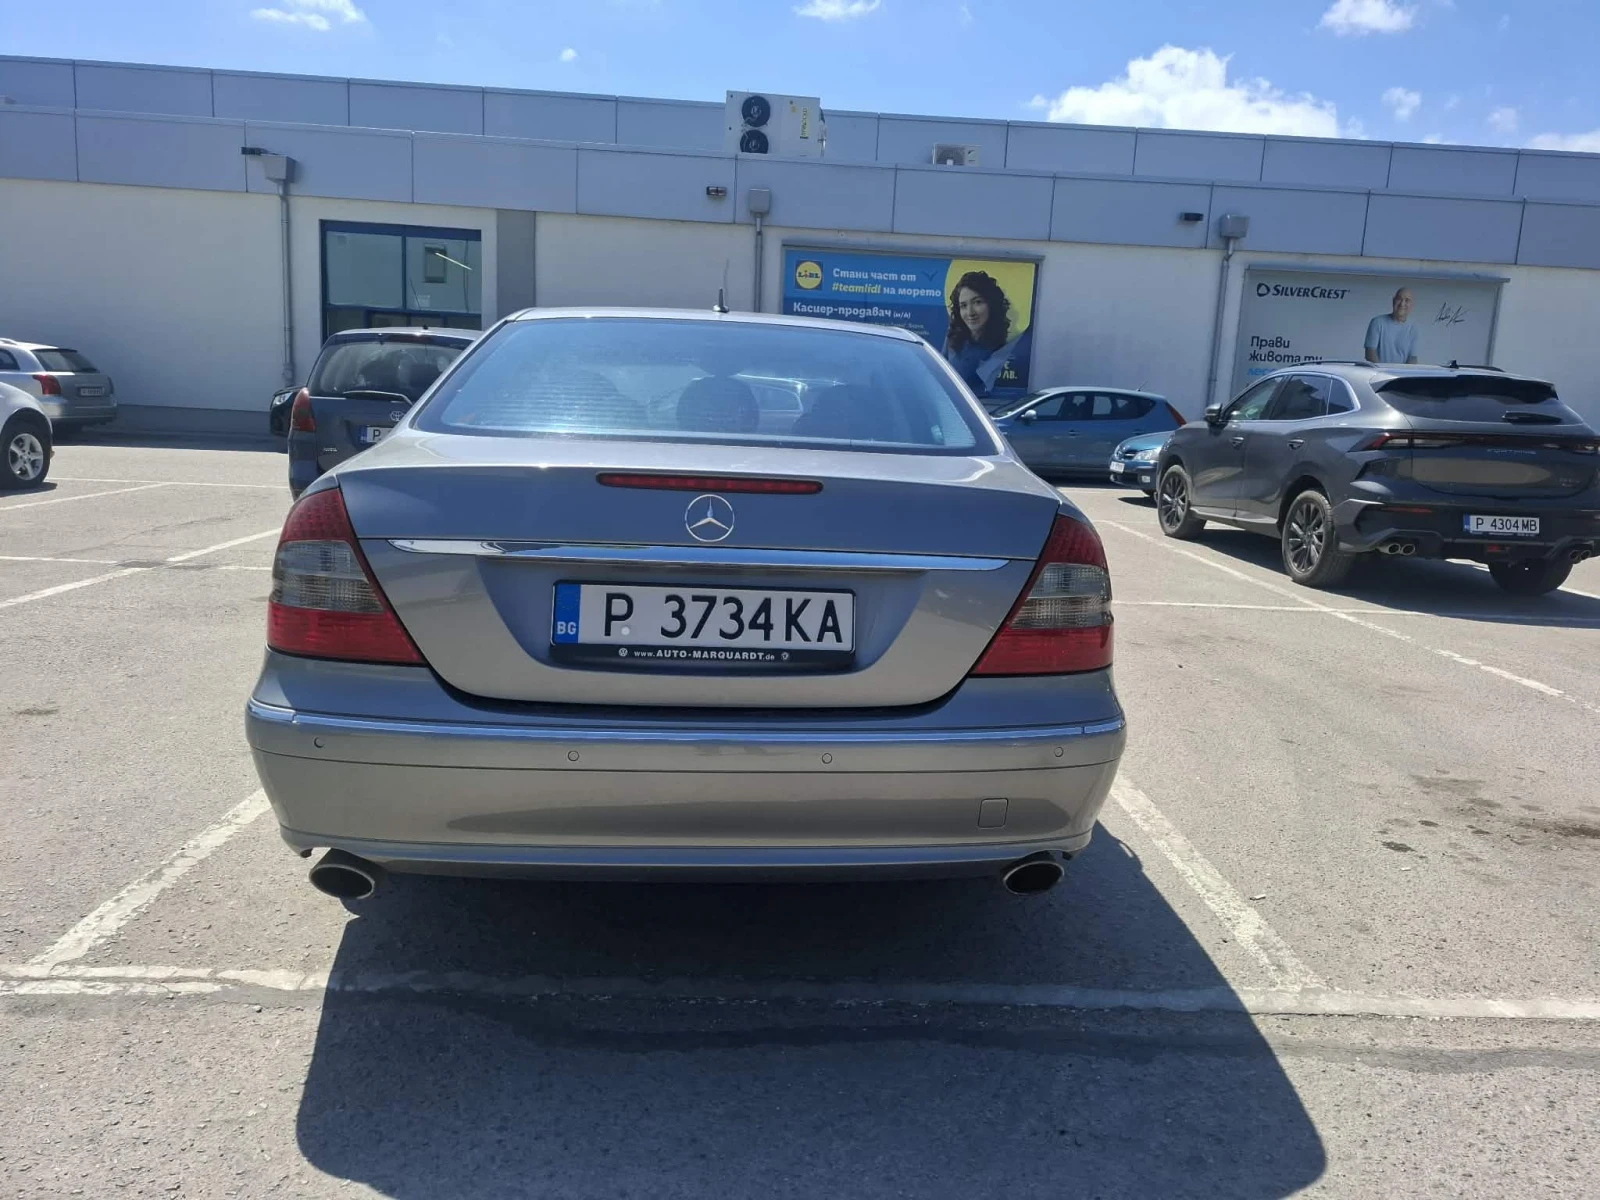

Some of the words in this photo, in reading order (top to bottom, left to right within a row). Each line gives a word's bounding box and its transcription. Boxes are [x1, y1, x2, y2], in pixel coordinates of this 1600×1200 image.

[832, 268, 869, 280] Стани
[870, 271, 898, 281] част
[900, 273, 917, 282] от
[831, 281, 881, 294] #teamlidl
[883, 287, 896, 295] на
[898, 287, 942, 298] морето
[793, 302, 892, 319] Касиер-продавач
[1250, 335, 1291, 350] Прави
[1249, 350, 1301, 363] живота
[1476, 517, 1484, 529] P
[604, 592, 634, 637] P
[556, 620, 577, 635] BG
[633, 650, 775, 661] www.AUTO-MARQUARDT.de
